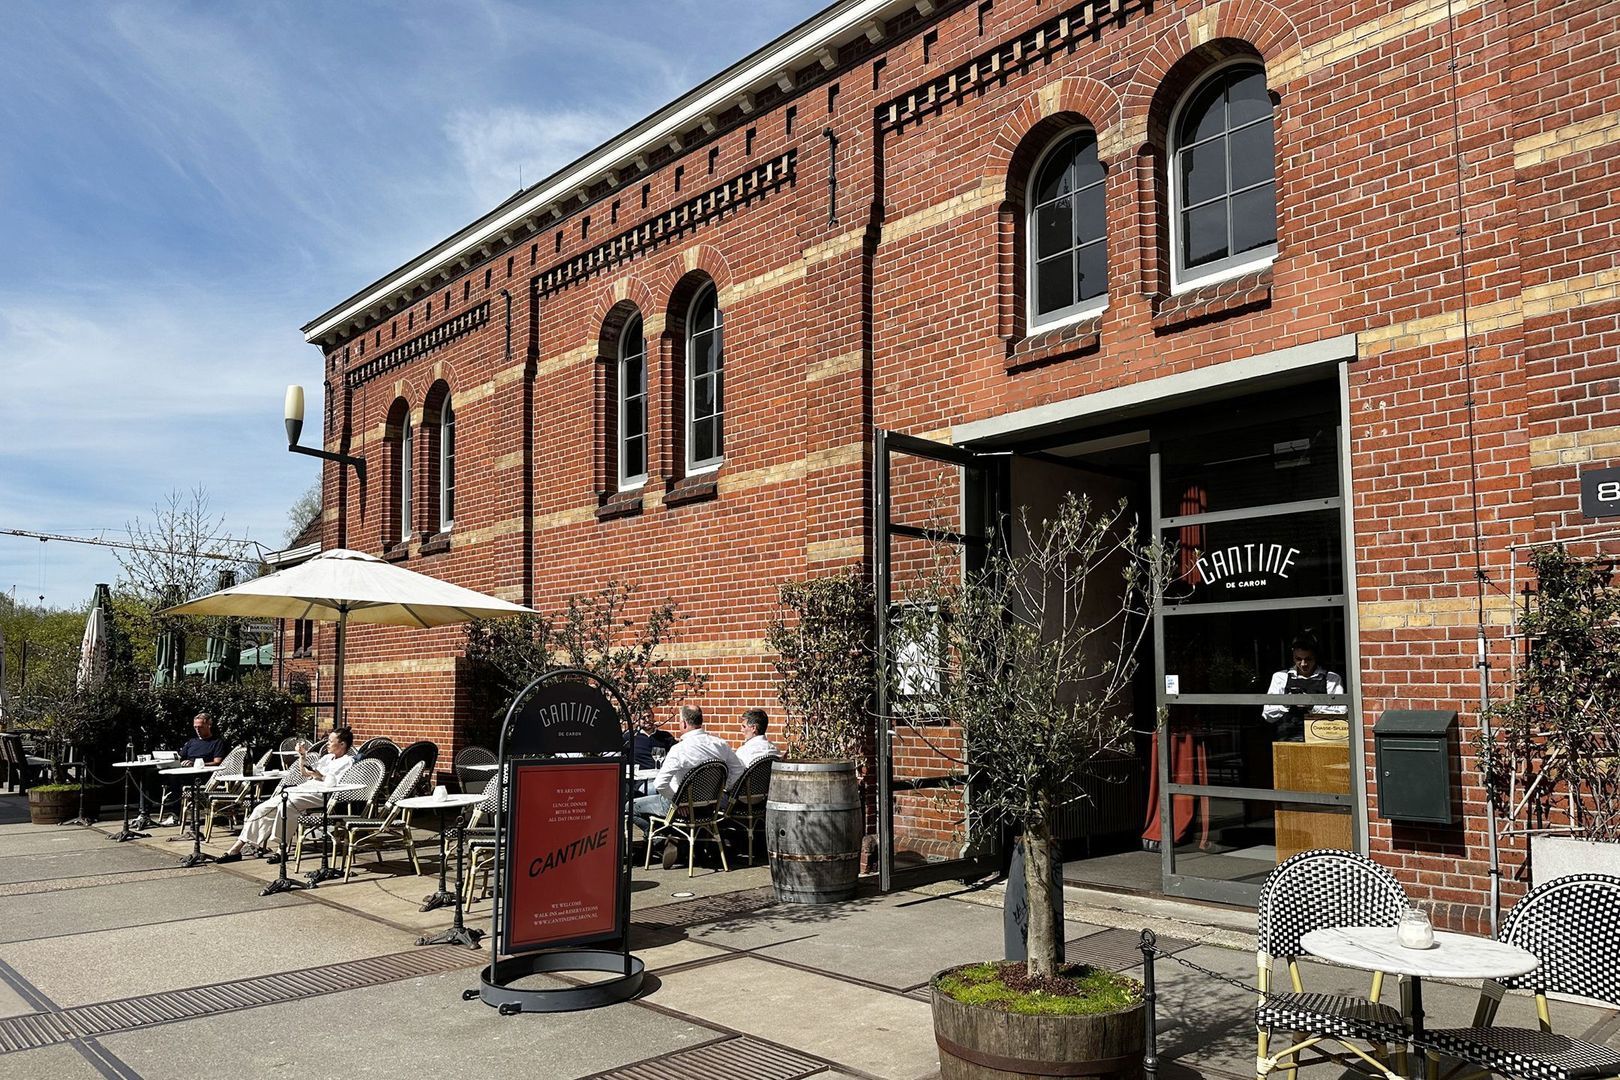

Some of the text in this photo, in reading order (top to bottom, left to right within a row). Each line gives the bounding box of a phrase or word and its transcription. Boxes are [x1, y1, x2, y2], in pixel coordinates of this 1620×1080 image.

[1196, 543, 1300, 585] CANTINE
[1238, 579, 1267, 588] CARON
[540, 702, 600, 727] CANTINE
[528, 827, 610, 878] CANTINE
[565, 906, 599, 914] RESERVATIONS
